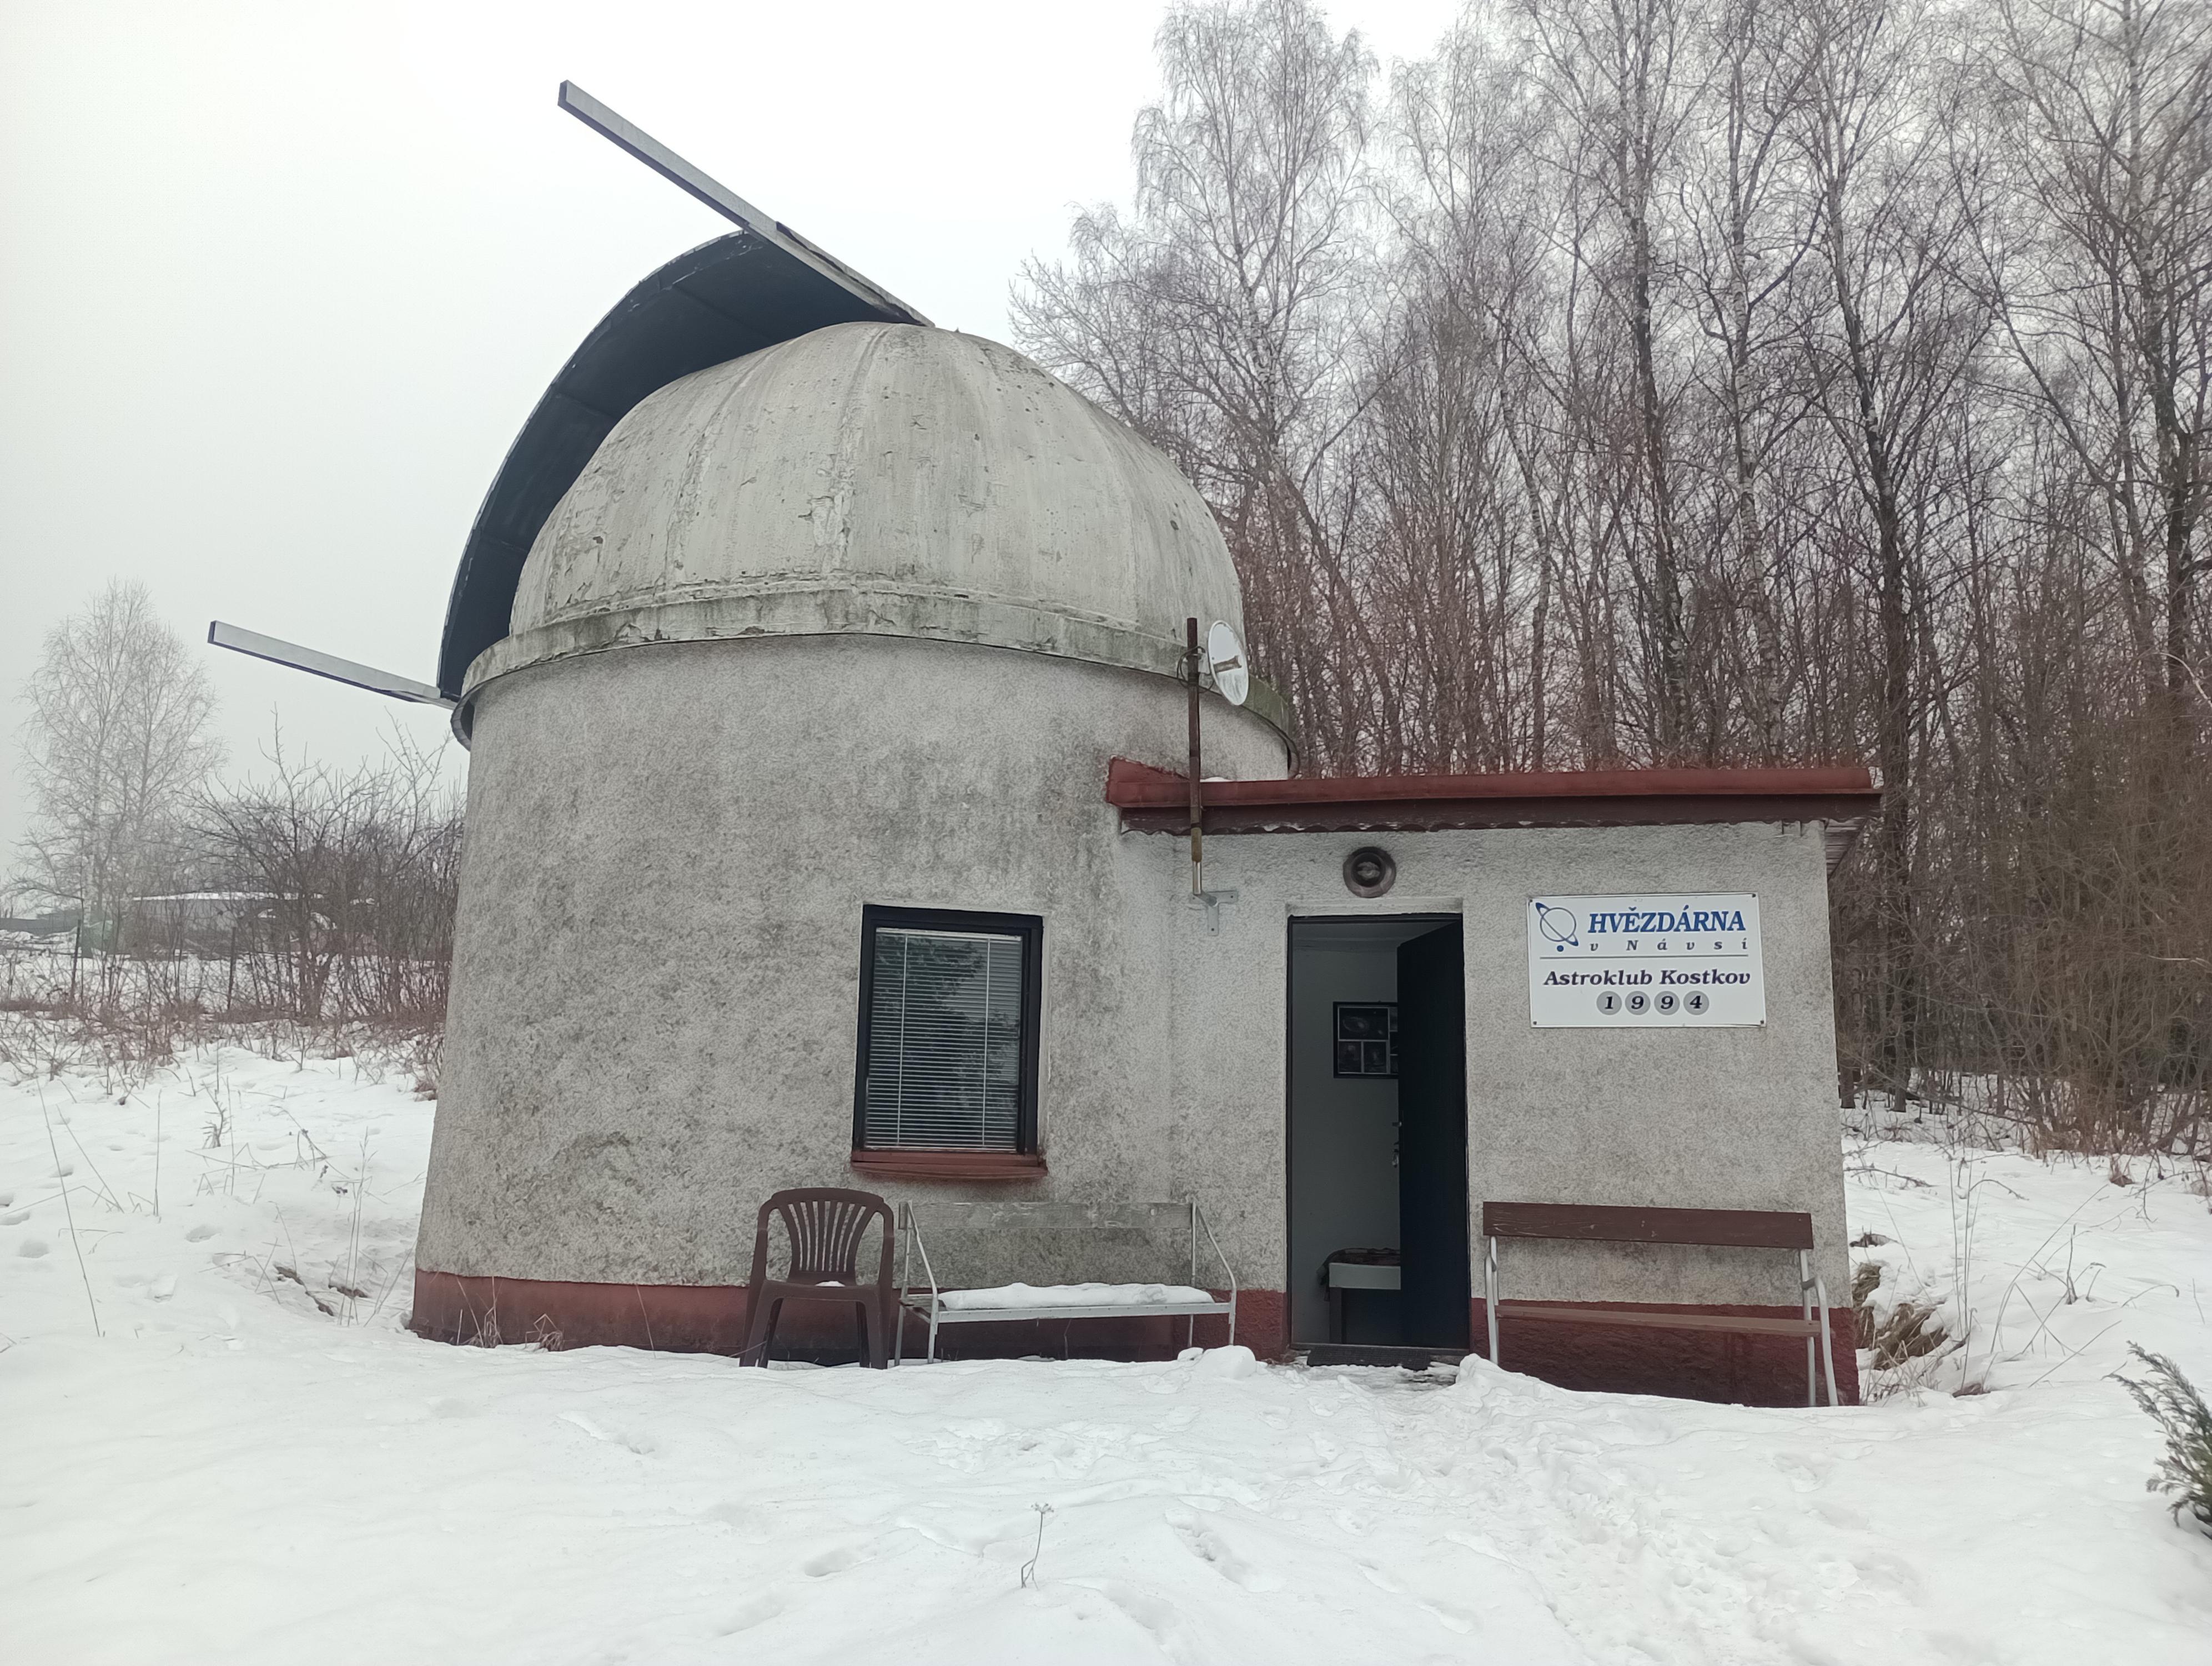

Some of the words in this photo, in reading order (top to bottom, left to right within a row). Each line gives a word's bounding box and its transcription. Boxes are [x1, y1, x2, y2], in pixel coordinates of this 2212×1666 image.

[1587, 904, 1746, 934] HVĚZDÁRNA
[1544, 970, 1653, 986] Astroklub
[1659, 969, 1751, 985] Kostkov
[1604, 995, 1703, 1010] 1994
